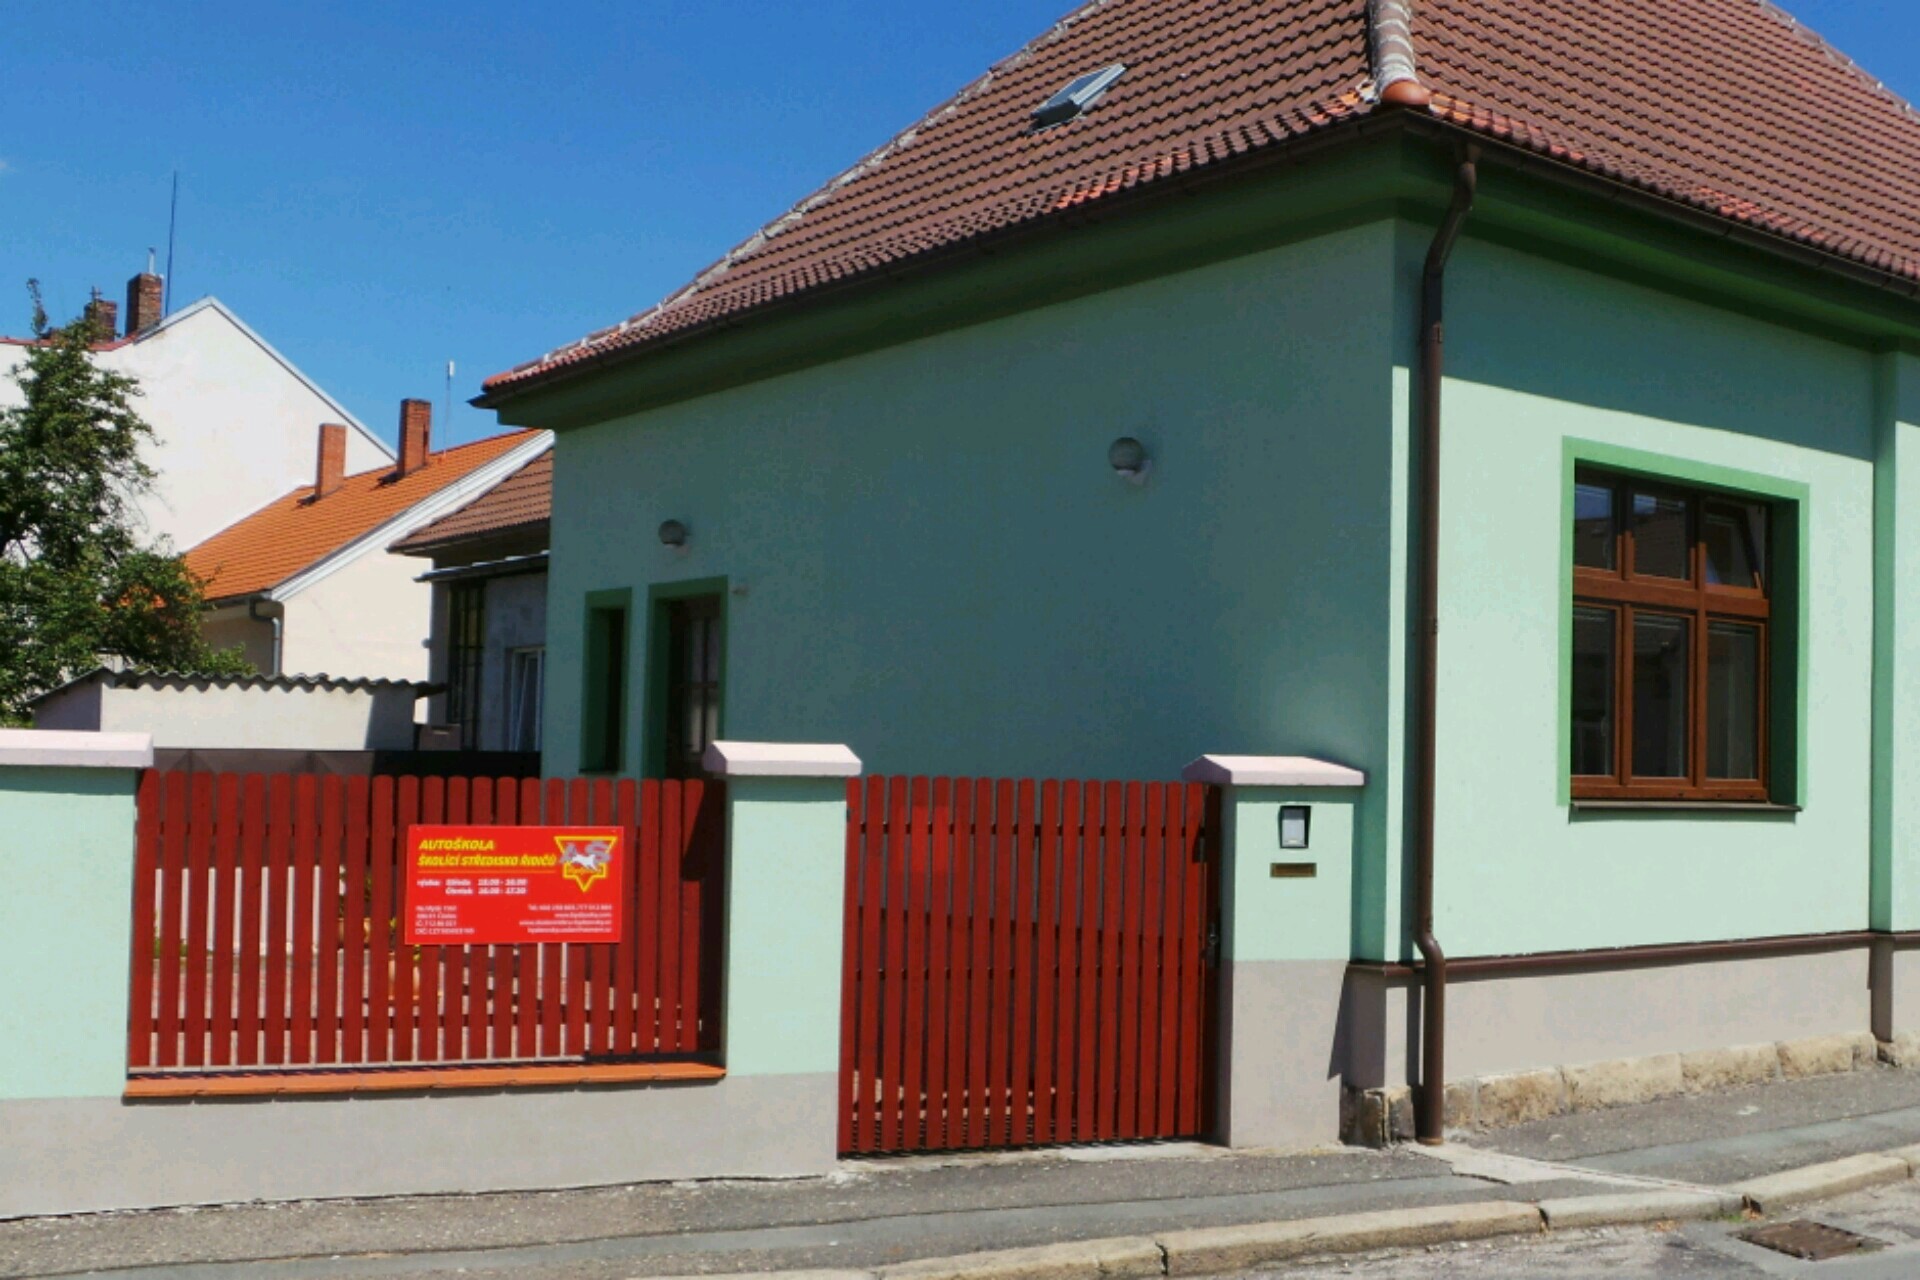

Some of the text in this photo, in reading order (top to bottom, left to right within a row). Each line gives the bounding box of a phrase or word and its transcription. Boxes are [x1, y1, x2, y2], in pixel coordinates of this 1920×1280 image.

[418, 838, 495, 850] AUTOŠKOLA
[461, 853, 518, 866] STŘEDISKO
[520, 853, 556, 866] ŘIDIČŮ
